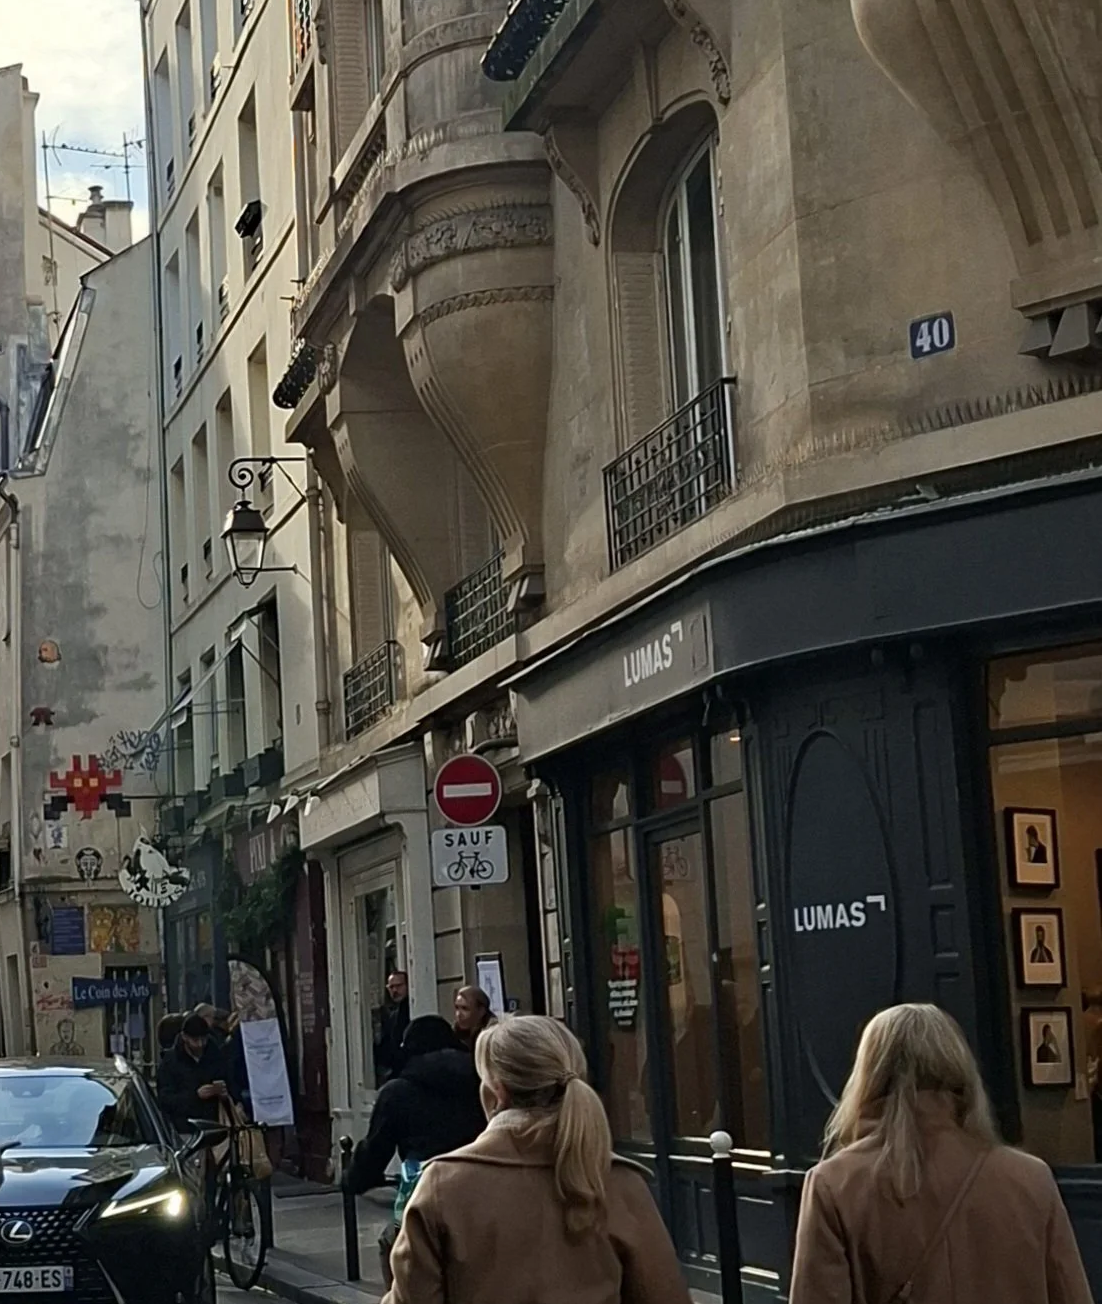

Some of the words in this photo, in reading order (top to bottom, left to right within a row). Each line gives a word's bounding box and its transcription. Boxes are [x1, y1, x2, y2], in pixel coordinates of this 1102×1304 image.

[912, 317, 952, 354] 40
[622, 633, 675, 688] LUMAS
[444, 830, 494, 848] SAUF
[792, 900, 868, 934] LUMAS
[74, 985, 86, 1001] Le
[88, 985, 111, 1000] Coin
[112, 982, 129, 999] des
[129, 982, 150, 998] Arts
